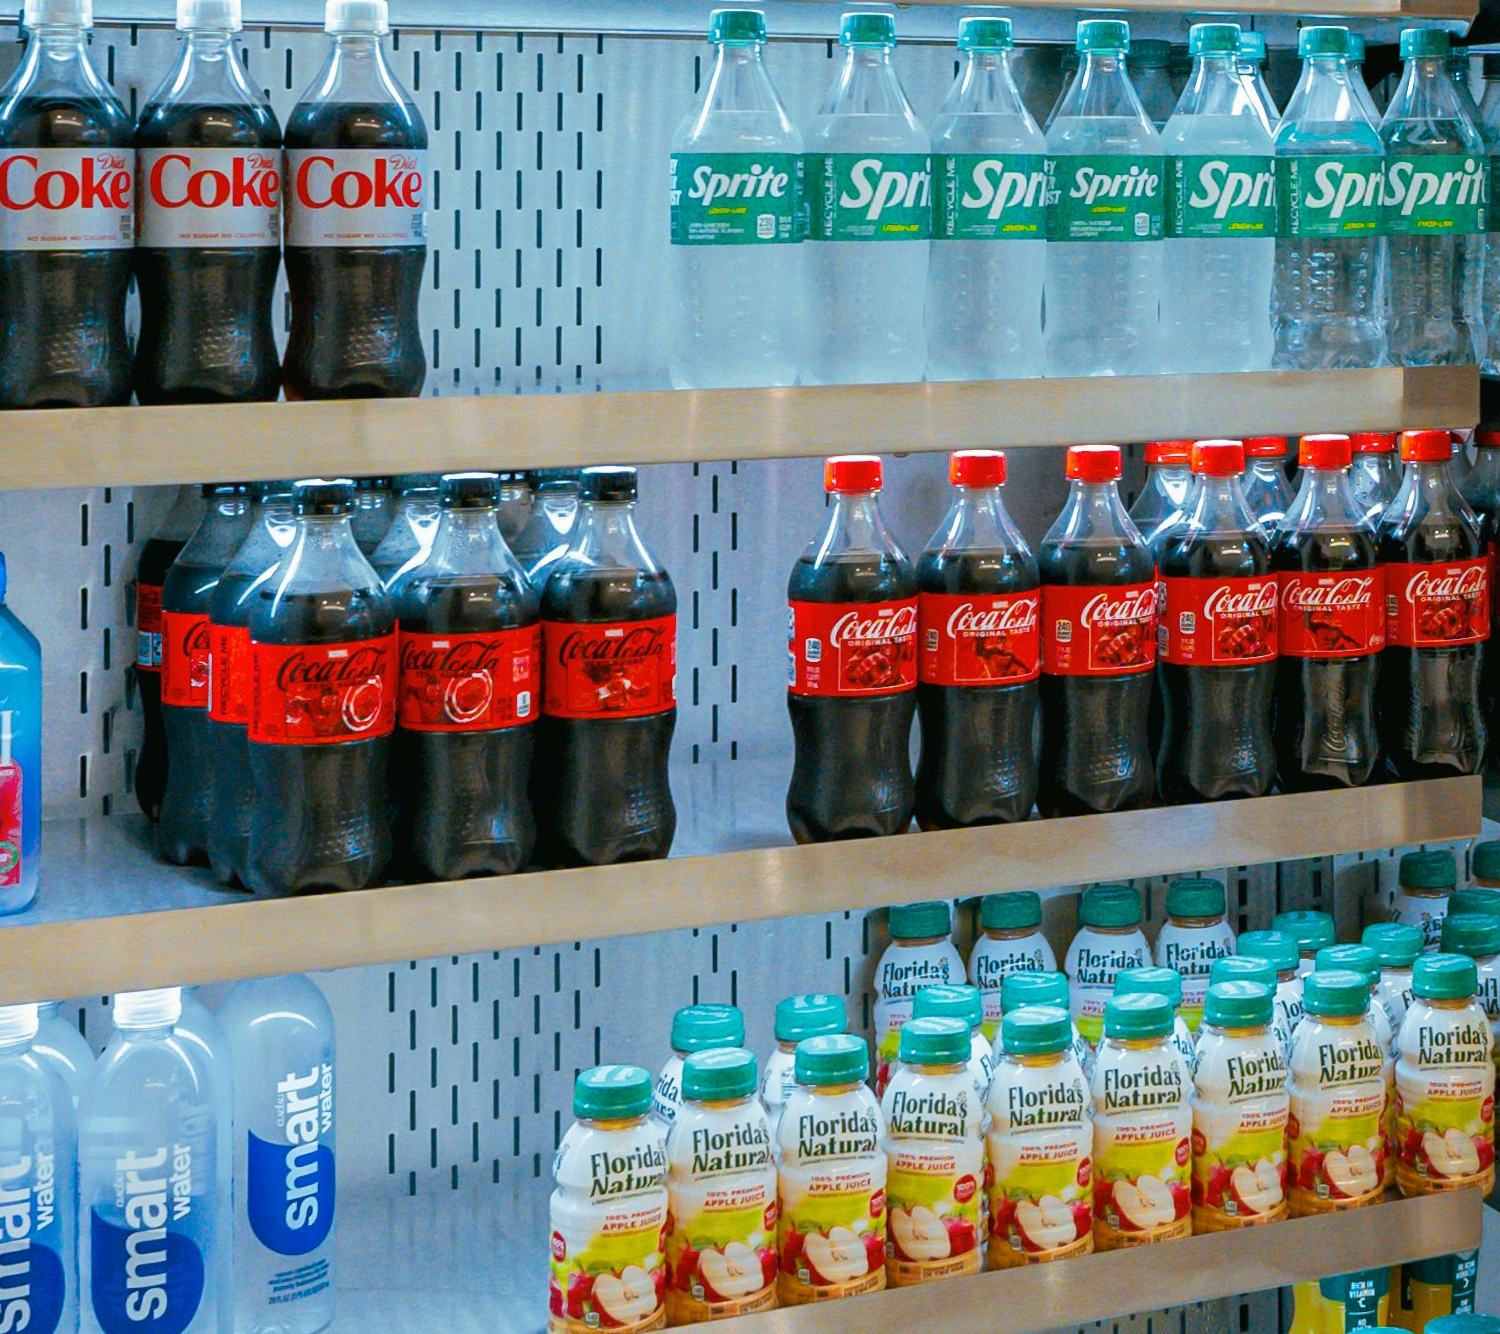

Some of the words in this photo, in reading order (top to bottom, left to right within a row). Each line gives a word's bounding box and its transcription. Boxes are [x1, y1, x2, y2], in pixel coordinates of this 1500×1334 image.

[97, 153, 126, 169] Diet
[248, 153, 275, 169] Diet
[390, 154, 418, 170] Diet
[825, 157, 833, 182] ME
[150, 154, 279, 208] Coke
[297, 156, 422, 209] Coke
[689, 164, 788, 205] Sprite
[961, 159, 1048, 219] Spr
[1070, 166, 1158, 204] Sprite
[1304, 161, 1384, 218] Spri
[1384, 158, 1486, 216] Sprit
[825, 185, 833, 236] RECYCLE
[1281, 577, 1374, 611] Coca-Cola
[1406, 566, 1486, 604] Coca-Cola
[947, 599, 1038, 639] Coca-Cola
[560, 626, 665, 667] Coca-Cola
[278, 646, 386, 692] Coca-Cola
[1418, 1047, 1487, 1064] Natural
[321, 1063, 332, 1132] water
[1105, 1087, 1181, 1109] Natural
[890, 1116, 966, 1137] Natural
[1009, 1106, 1082, 1129] Natural
[1150, 1128, 1176, 1138] JUICE
[277, 1066, 319, 1230] smart
[692, 1148, 770, 1174] Natural
[797, 1136, 877, 1159] Natural
[37, 1154, 54, 1230] water
[174, 1144, 191, 1220] water
[590, 1172, 663, 1197] Natura
[704, 1198, 737, 1207] APPLE
[740, 1192, 766, 1204] JUICE
[808, 1182, 842, 1192] APPLE
[845, 1179, 872, 1190] JUICE
[116, 1147, 167, 1321] smart
